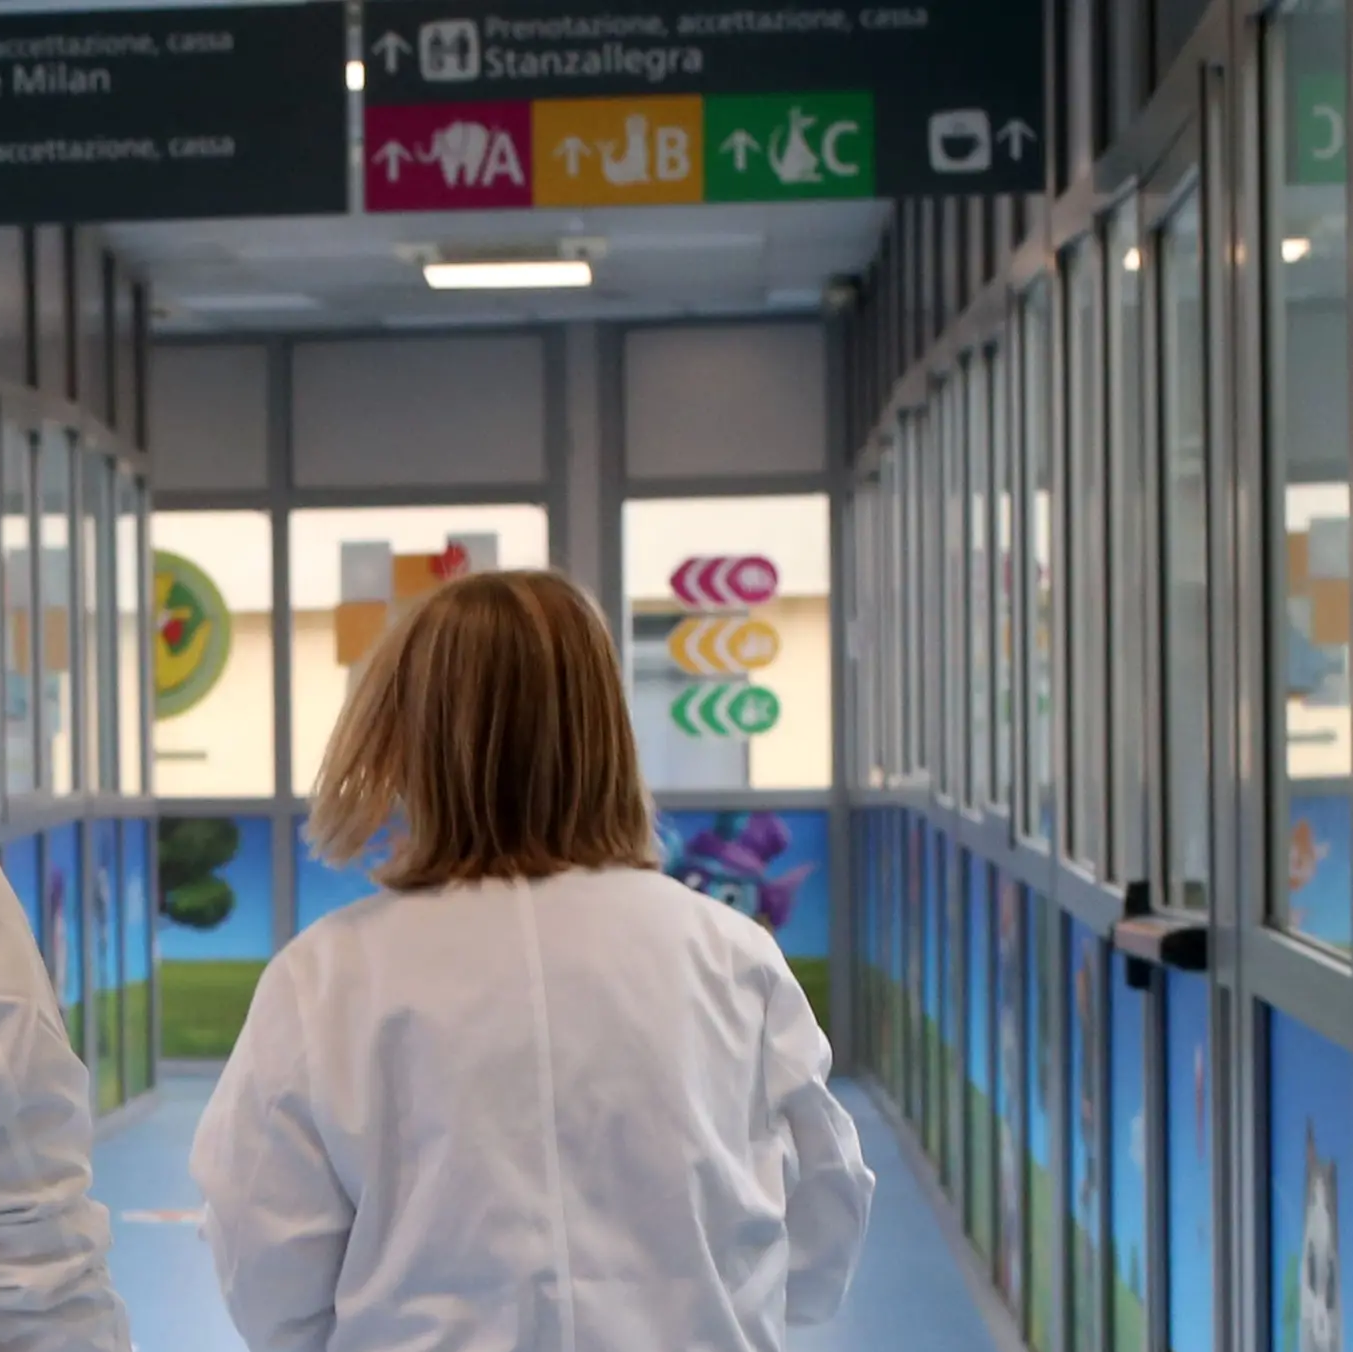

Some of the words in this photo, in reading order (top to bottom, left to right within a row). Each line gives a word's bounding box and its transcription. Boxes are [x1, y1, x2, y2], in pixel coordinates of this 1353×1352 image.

[485, 14, 668, 39] Prenotazione,
[859, 8, 928, 30] cassa
[166, 31, 234, 54] cassa
[13, 62, 111, 97] Milan
[485, 42, 703, 82] Stanzallegra
[168, 135, 236, 159] cassa
[482, 126, 524, 186] A
[657, 127, 690, 180] B
[822, 121, 860, 177] C
